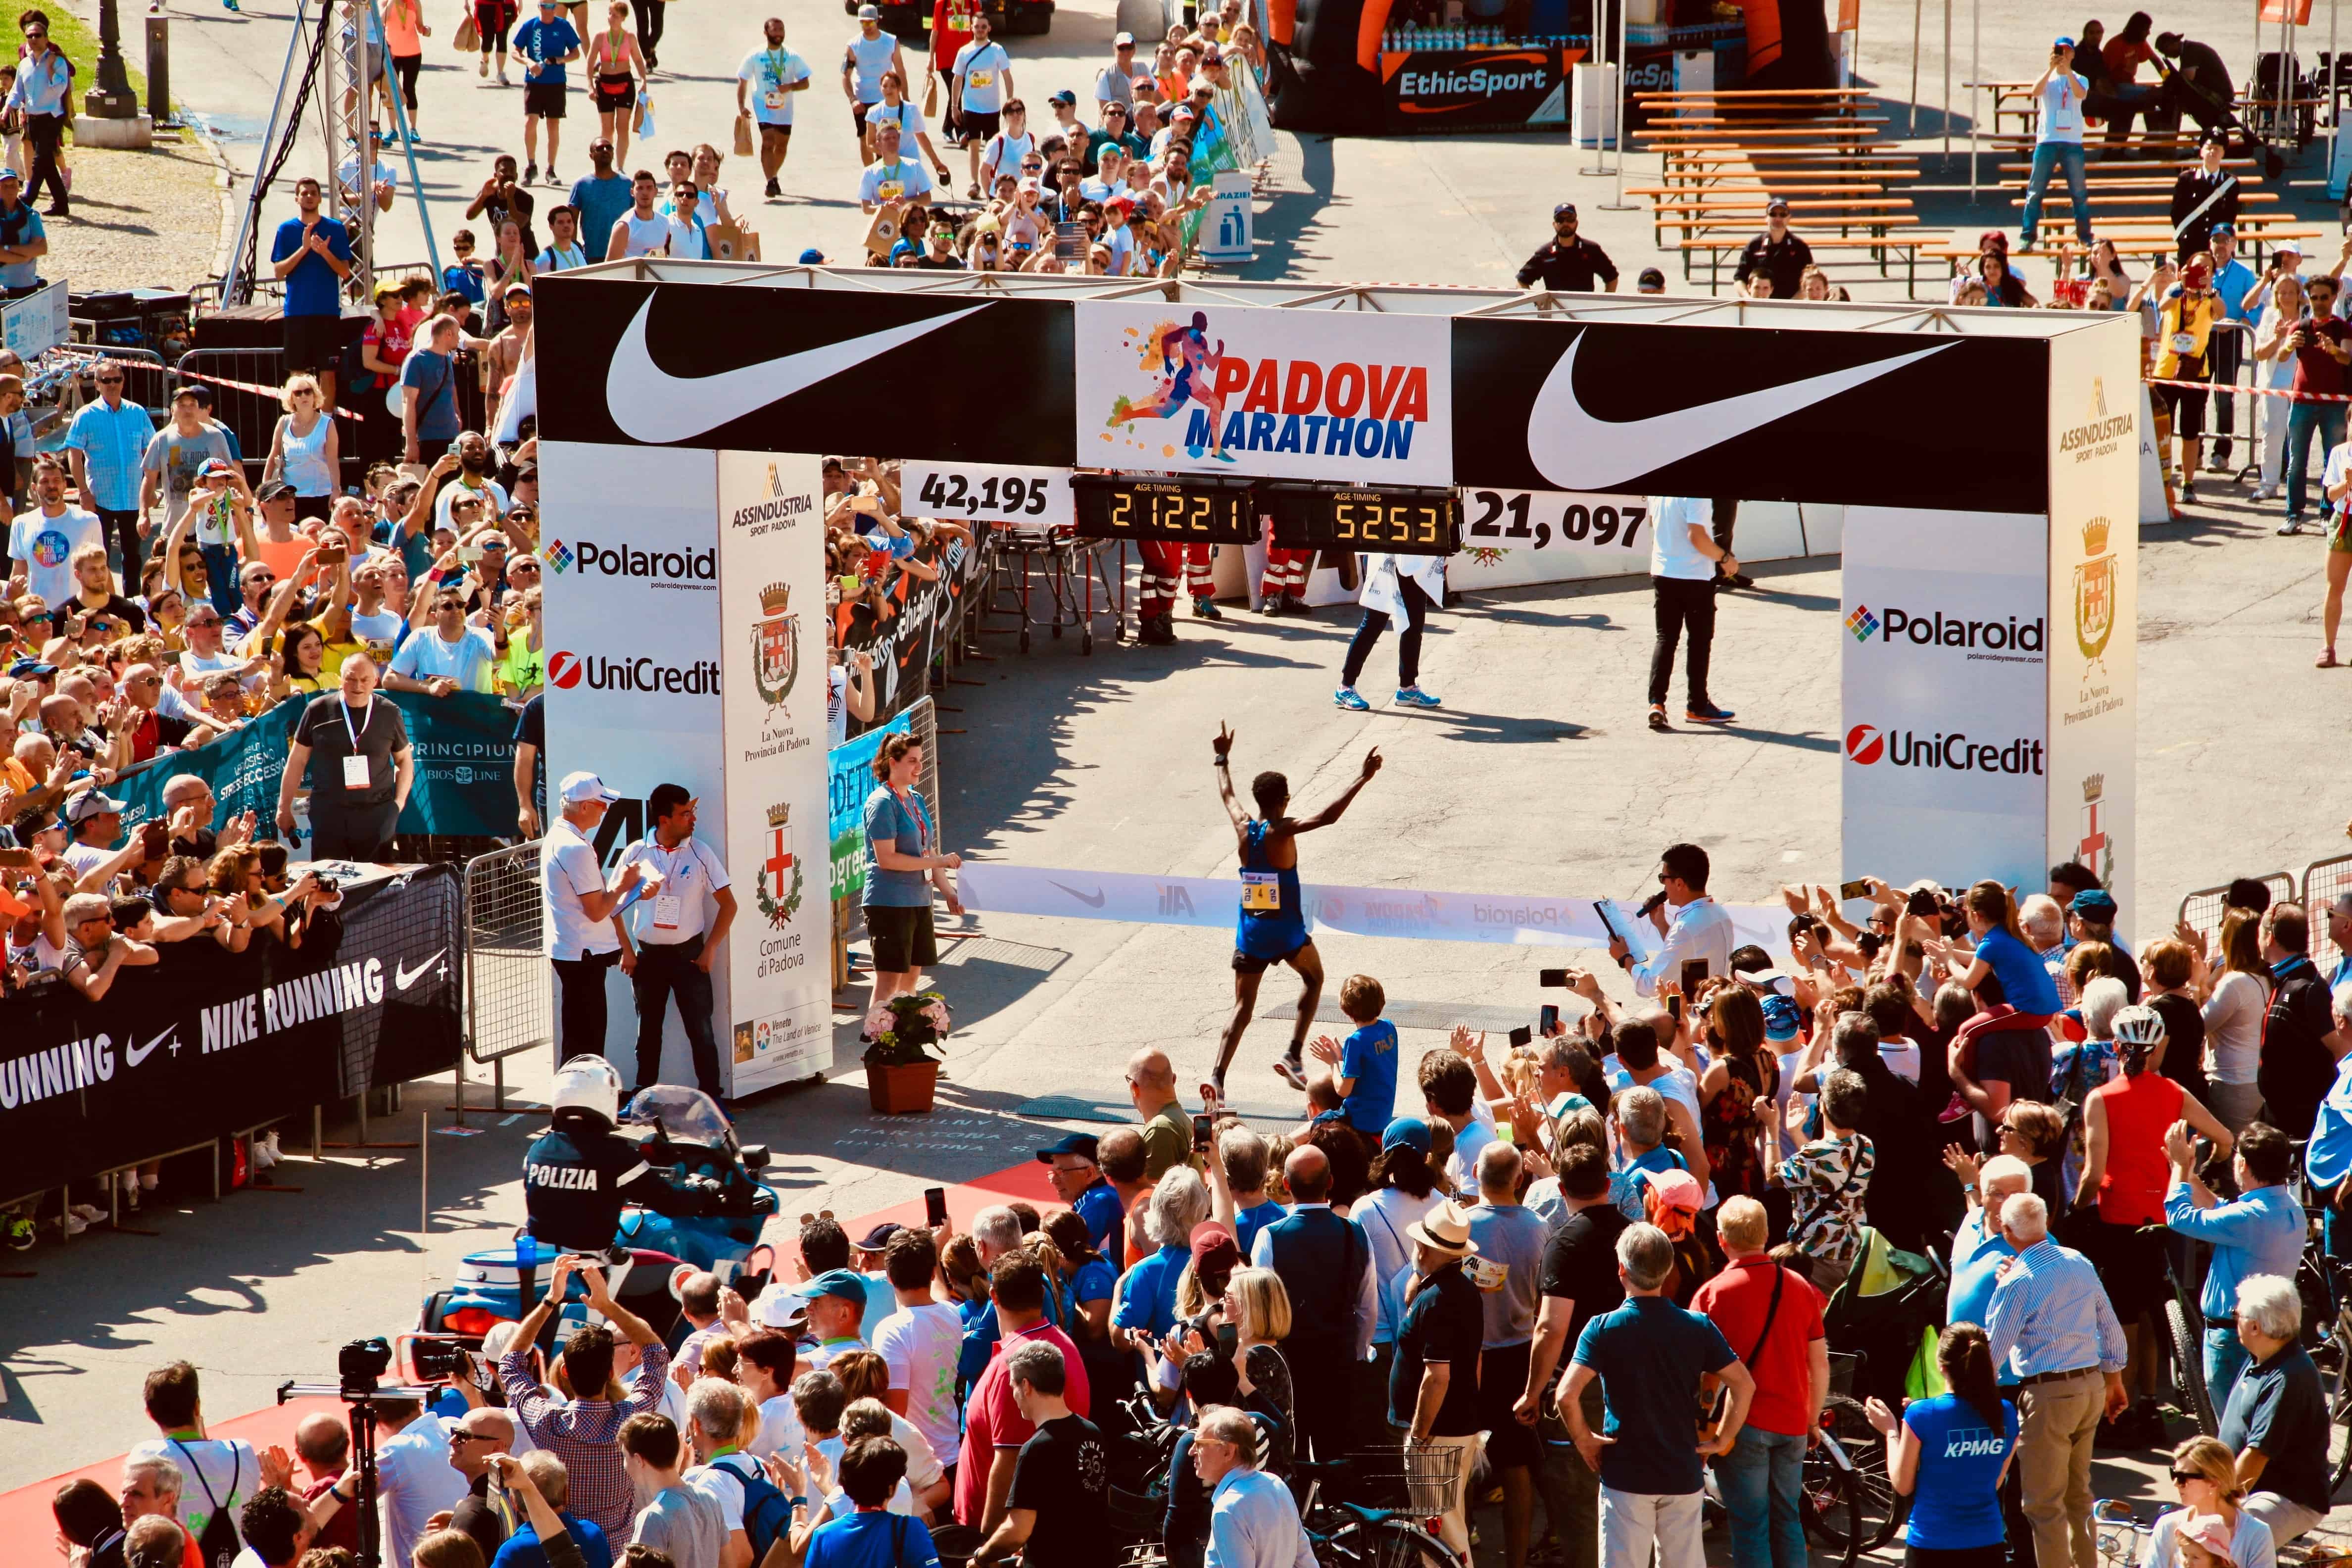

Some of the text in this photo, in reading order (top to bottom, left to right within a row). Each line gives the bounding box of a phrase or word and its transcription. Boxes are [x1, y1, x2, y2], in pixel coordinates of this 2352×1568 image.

[1400, 68, 1547, 98] EthicSport
[1214, 358, 1428, 423] PADOVA
[1184, 409, 1414, 459] MARATHON
[2059, 413, 2133, 454] ASSINDUSTRIA
[2075, 441, 2118, 464] SPORT PADOVA
[919, 473, 1049, 516] 42,195
[732, 494, 812, 529] ASSINDUSTRIA
[749, 518, 796, 537] SPORT PADOVA
[43, 536, 56, 545] THE
[43, 554, 56, 564] RUN
[577, 541, 716, 580] Polaroid
[650, 581, 717, 591] polaroideyewear.com
[1883, 608, 2043, 652] Polaroid
[1966, 652, 2044, 664] polaroideyewear.com
[587, 655, 721, 695] UniCredit
[2080, 684, 2109, 704] La Nuova
[2064, 696, 2123, 726] Provincia di Padova
[761, 726, 794, 743] La Nuova
[744, 736, 810, 762] Provincia di Padova
[1889, 730, 2044, 776] UniCredit
[427, 770, 501, 781] BIOS LINE
[760, 932, 801, 955] Comune
[757, 954, 804, 978] di Padova
[201, 958, 384, 1054] NIKE RUNNING
[772, 1018, 791, 1031] Veneto
[773, 1023, 822, 1045] The Land of Venice
[528, 1163, 598, 1191] POLIZIA
[1464, 1257, 1482, 1271] Ali
[1944, 1438, 2005, 1458] KPMG
